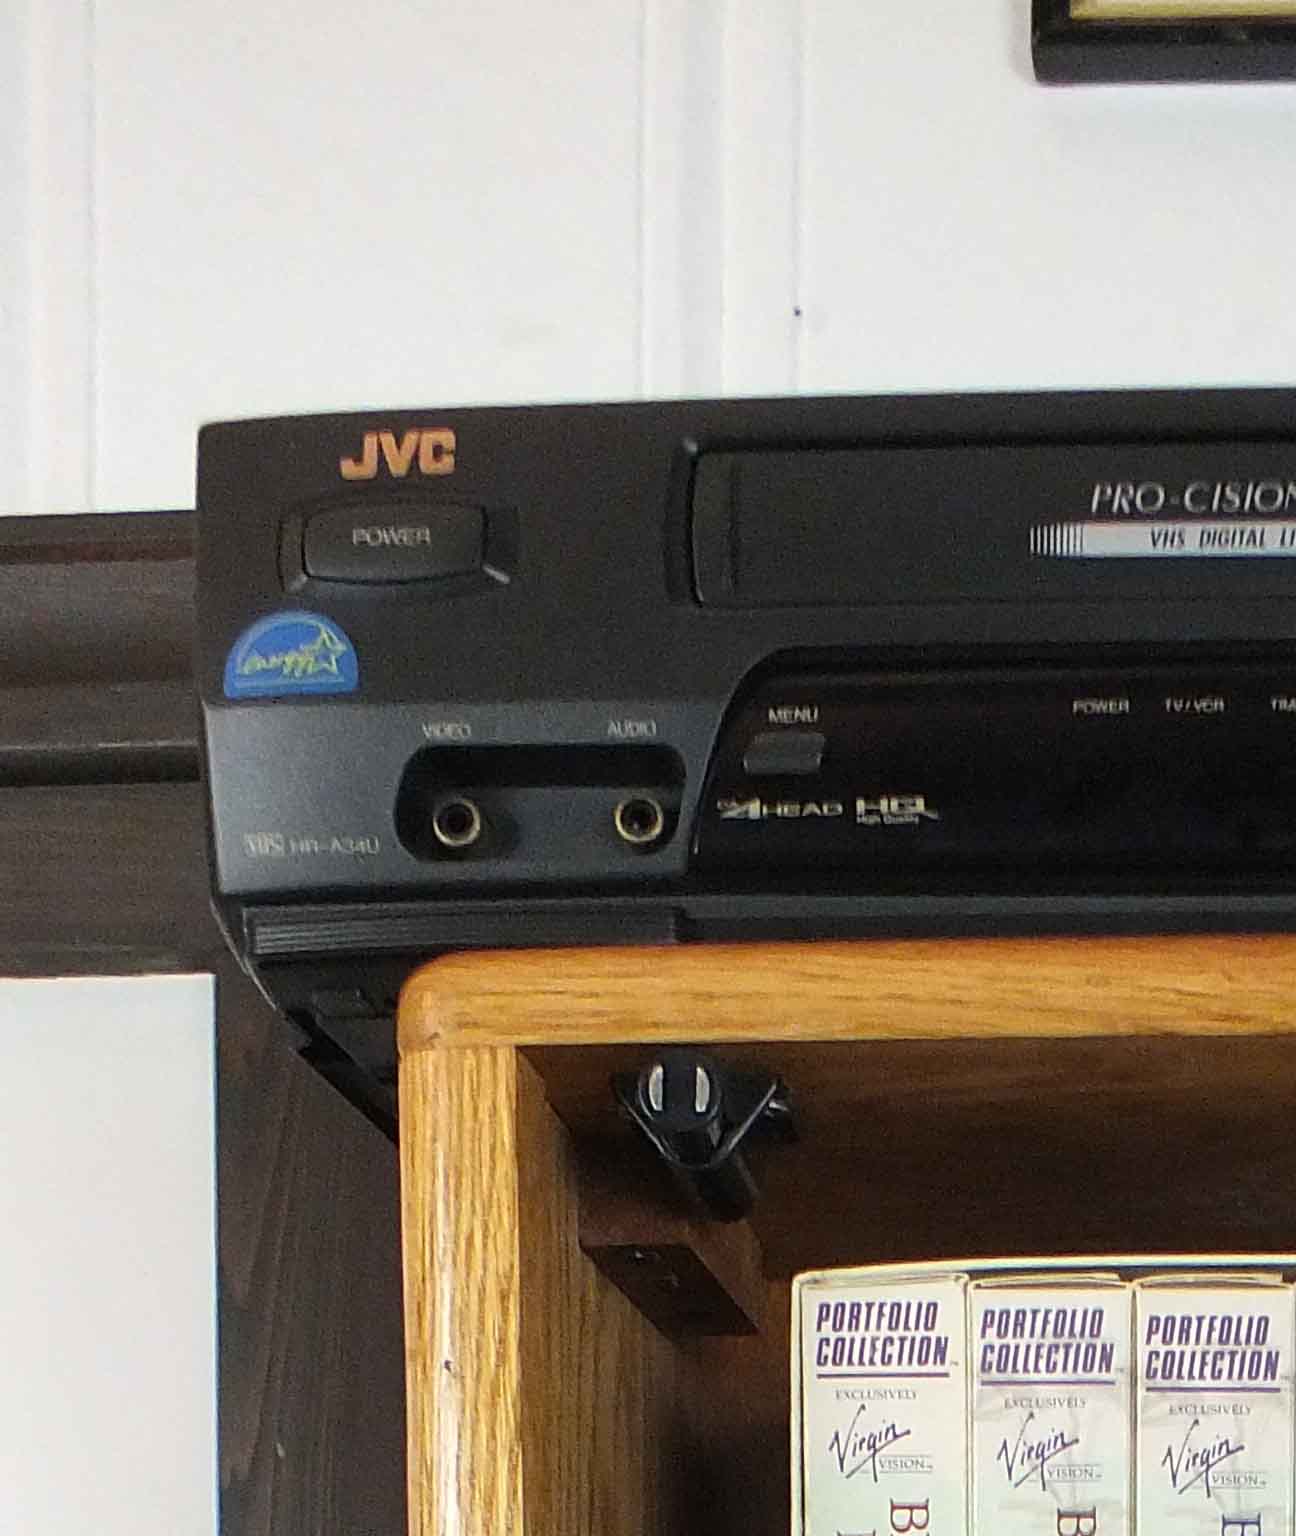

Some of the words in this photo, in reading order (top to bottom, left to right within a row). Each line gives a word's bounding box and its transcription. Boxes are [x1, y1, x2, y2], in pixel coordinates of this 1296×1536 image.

[340, 427, 456, 480] JVC
[352, 526, 431, 547] POWER
[1150, 528, 1187, 550] VHS
[1198, 528, 1266, 549] DIGITAL
[768, 706, 819, 724] MENU
[1072, 698, 1130, 714] POWER
[1164, 697, 1224, 713] TV/VCR
[422, 722, 471, 738] VIDEO
[607, 720, 657, 737] AUDIO
[816, 1301, 939, 1333] PORTFOLIO
[980, 1308, 1105, 1339] PORTFOLIO
[1145, 1315, 1270, 1346] PORTFOLIO
[816, 1335, 949, 1368] COLLECTION
[980, 1342, 1115, 1375] COLLECTION
[1145, 1350, 1280, 1382] COLLECTION
[835, 1389, 918, 1400] EXCLUSIVELY
[829, 1404, 912, 1483] Virgin
[879, 1459, 925, 1471] VISION
